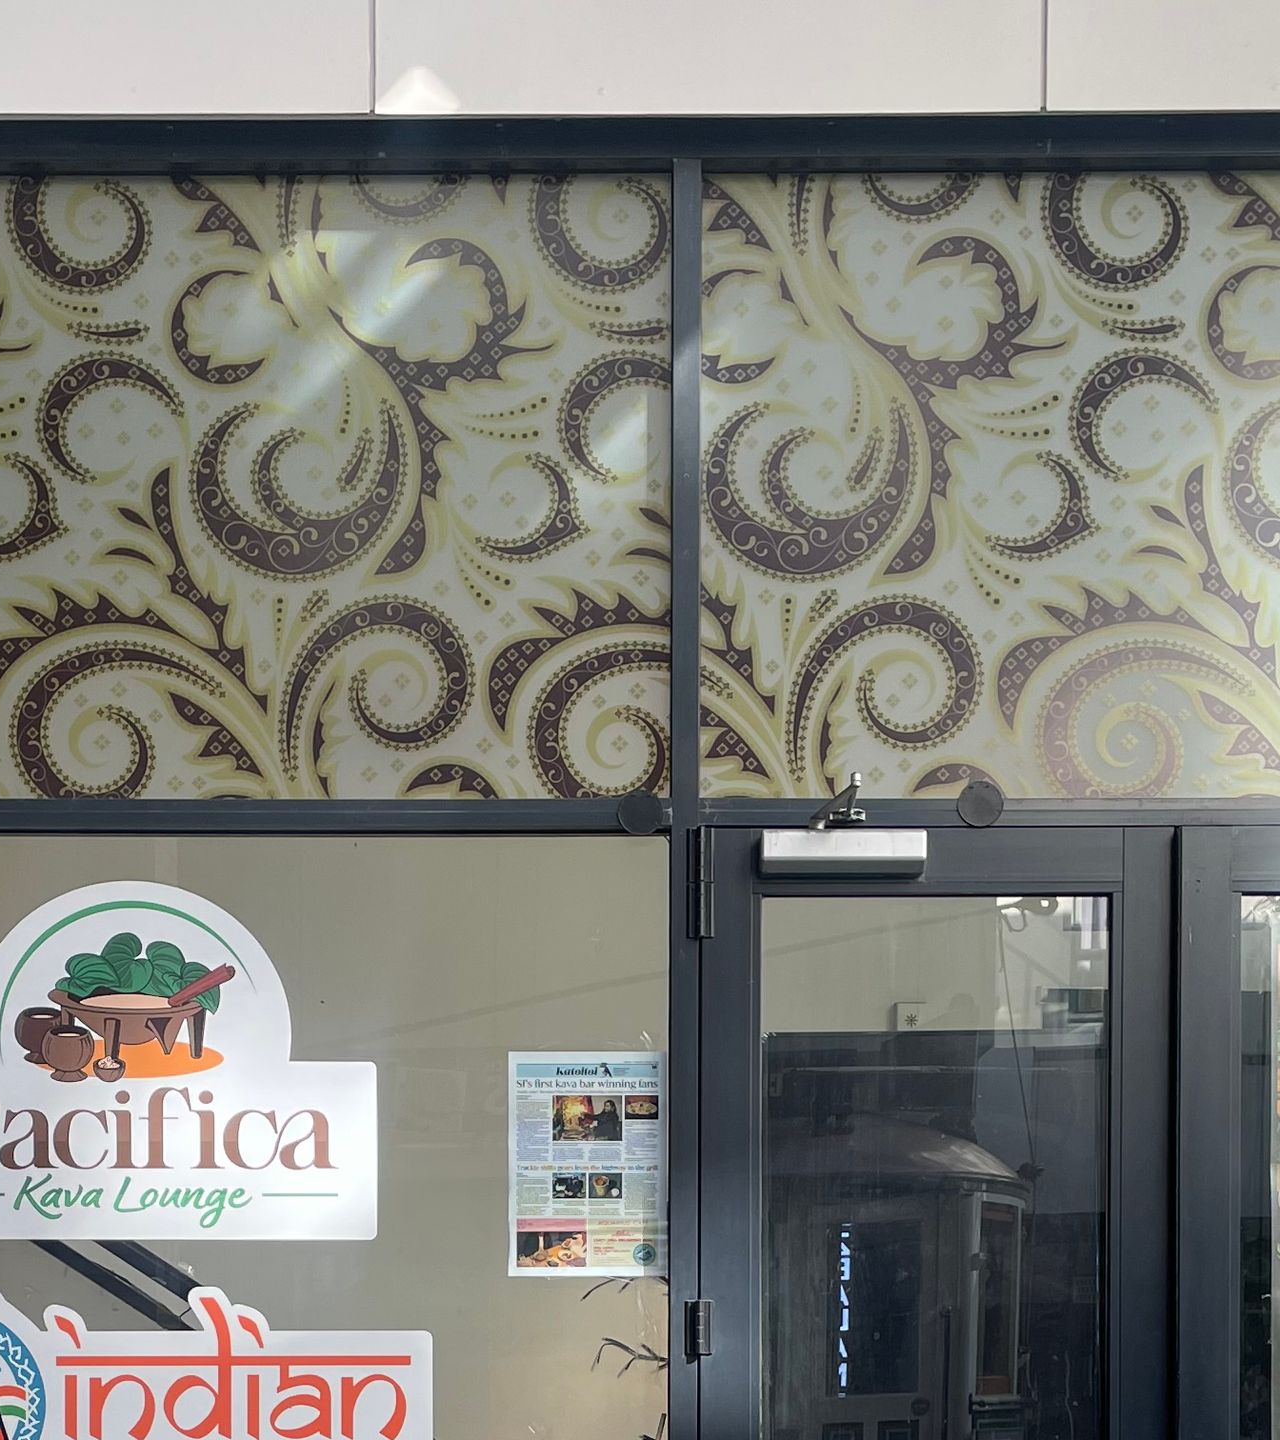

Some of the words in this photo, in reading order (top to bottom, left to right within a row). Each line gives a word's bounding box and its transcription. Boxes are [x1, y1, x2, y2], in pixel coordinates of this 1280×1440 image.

[535, 1078, 553, 1088] first
[556, 1078, 578, 1088] kava
[580, 1078, 595, 1088] bar
[597, 1079, 637, 1090] winning
[639, 1079, 658, 1089] fans
[13, 1172, 104, 1220] Kava
[112, 1175, 252, 1229] Lounge
